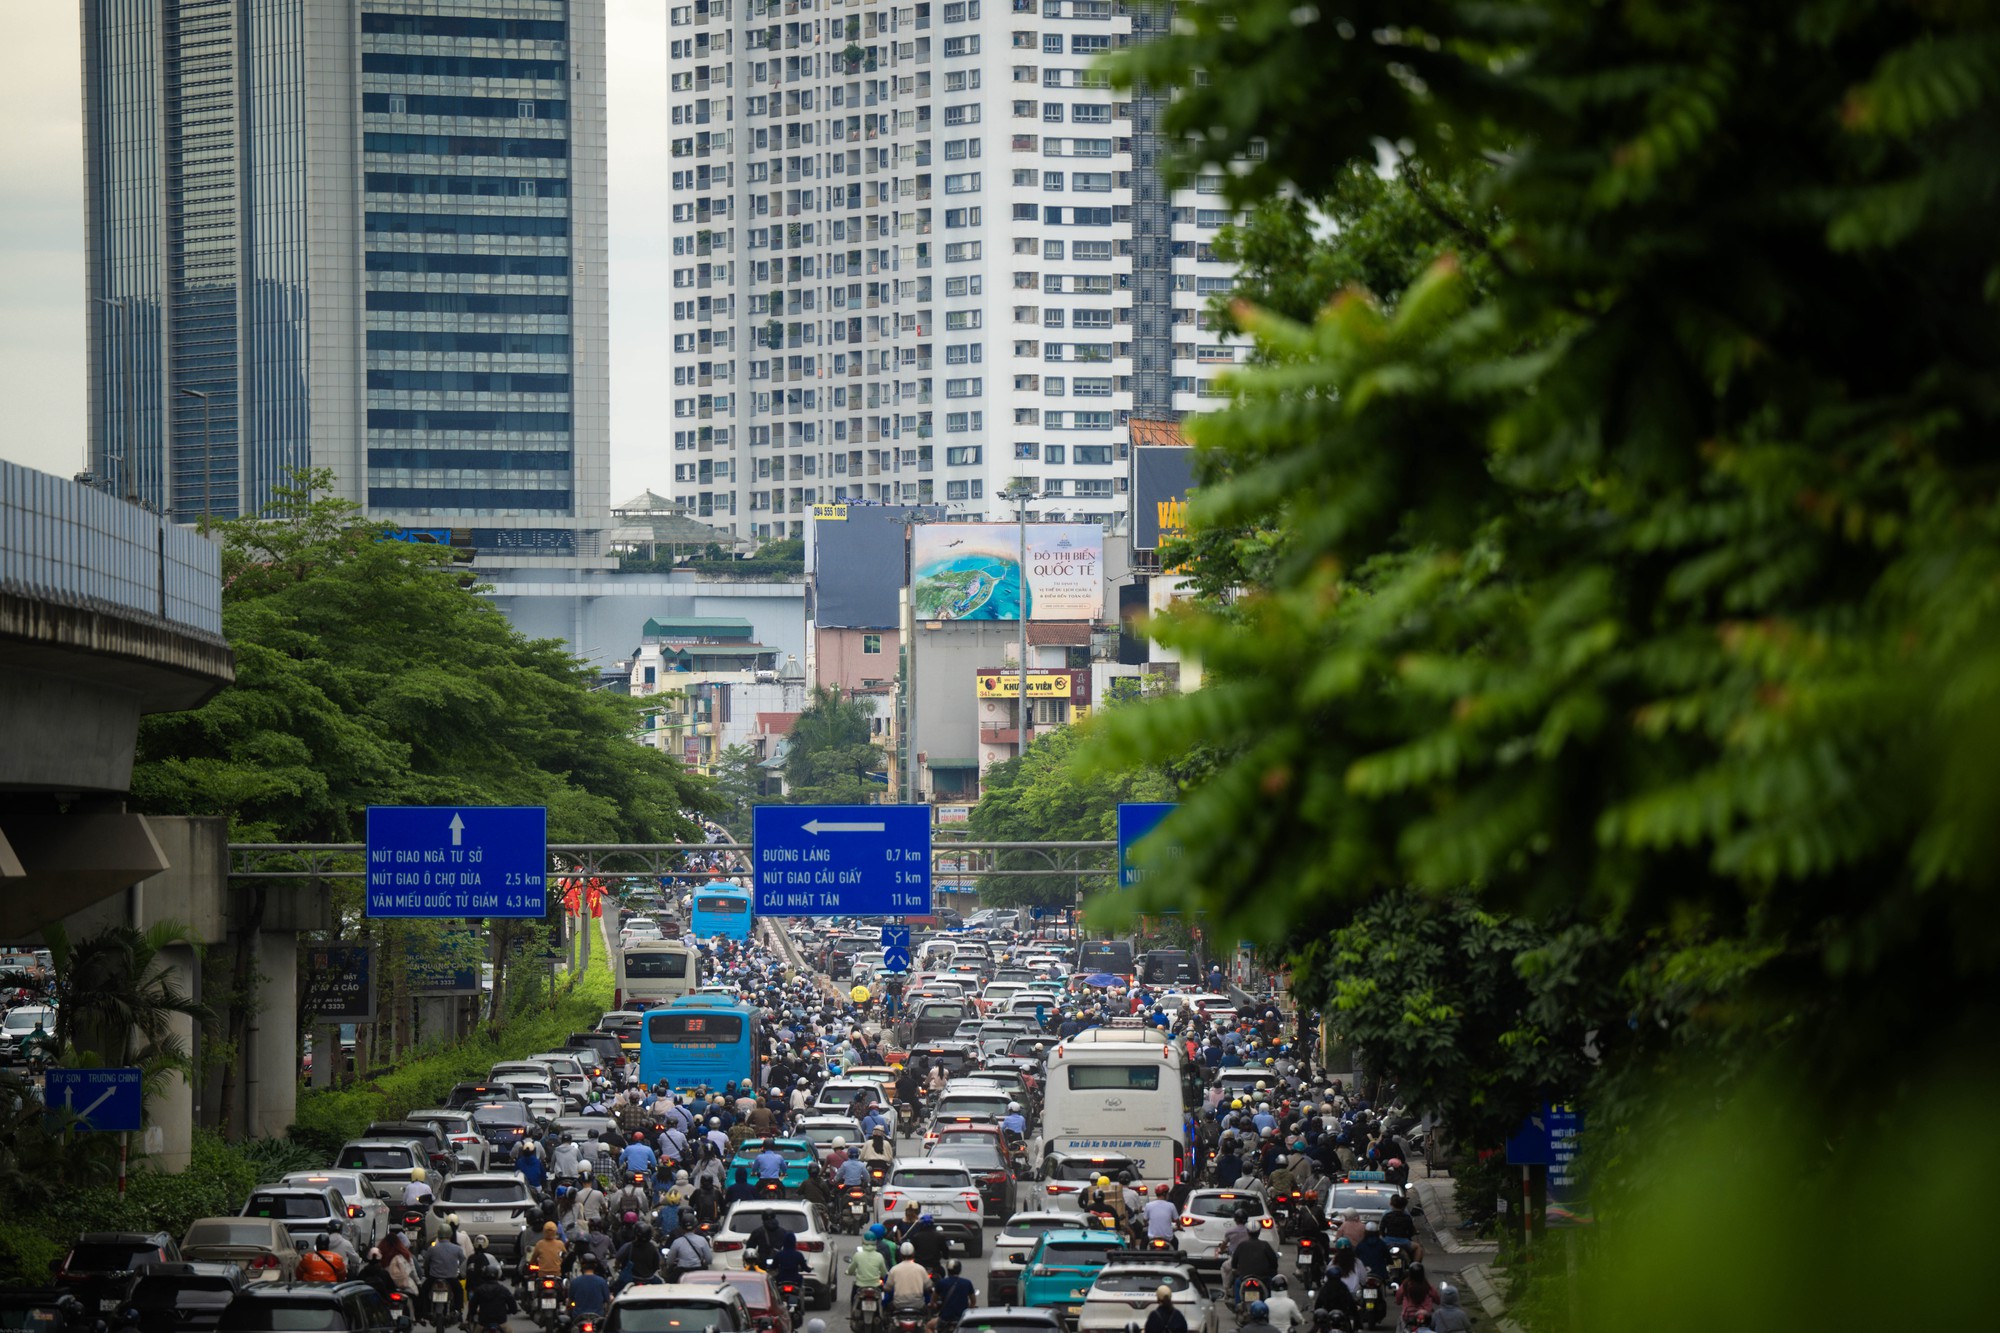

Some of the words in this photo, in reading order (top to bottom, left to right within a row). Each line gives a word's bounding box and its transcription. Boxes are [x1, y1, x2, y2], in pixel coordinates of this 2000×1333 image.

[1034, 550, 1051, 560] ĐÔ
[1053, 552, 1071, 562] THỊ
[1034, 561, 1074, 577] QUỐC
[1077, 561, 1096, 576] TẾ
[1003, 682, 1034, 691] KHƯNG
[1035, 681, 1052, 690] VIÊN
[372, 847, 392, 863] NÚT
[396, 850, 420, 863] GIAO
[424, 848, 445, 863] NGÃ
[450, 850, 464, 863] TƯ
[469, 846, 483, 863] SỞ
[763, 846, 799, 861] ĐƯỜNG
[802, 845, 830, 861] LÁNG
[905, 849, 921, 861] km
[372, 869, 392, 885] NÚT
[396, 873, 420, 885] GIAO
[424, 870, 431, 885] Ô
[435, 872, 456, 888] CHỢ
[461, 869, 481, 885] DỪA
[525, 873, 541, 885] km
[763, 868, 783, 884] NÚT
[787, 872, 811, 884] GIAO
[815, 867, 834, 884] CẦU
[839, 867, 862, 884] GIẤY
[895, 871, 902, 884] 5
[905, 871, 921, 884] km
[373, 893, 393, 907] VĂN
[396, 891, 421, 907] MIẾU
[424, 891, 452, 907] QUỐC
[455, 891, 470, 907] TỬ
[472, 892, 498, 907] GIÁM
[525, 895, 541, 907] km
[763, 890, 784, 906] CẦU
[787, 892, 815, 908] NHẬT
[820, 892, 840, 906] TÂN
[892, 894, 902, 906] 11
[905, 893, 922, 906] km
[341, 982, 360, 991] CÁO
[688, 1019, 703, 1031] 27
[52, 1073, 64, 1083] TÂY
[66, 1073, 81, 1083] SƠN
[88, 1072, 116, 1083] TRƯỜNG
[118, 1073, 139, 1083] CHINH
[1119, 1140, 1132, 1148] Làm
[1133, 1139, 1152, 1148] Phiền
